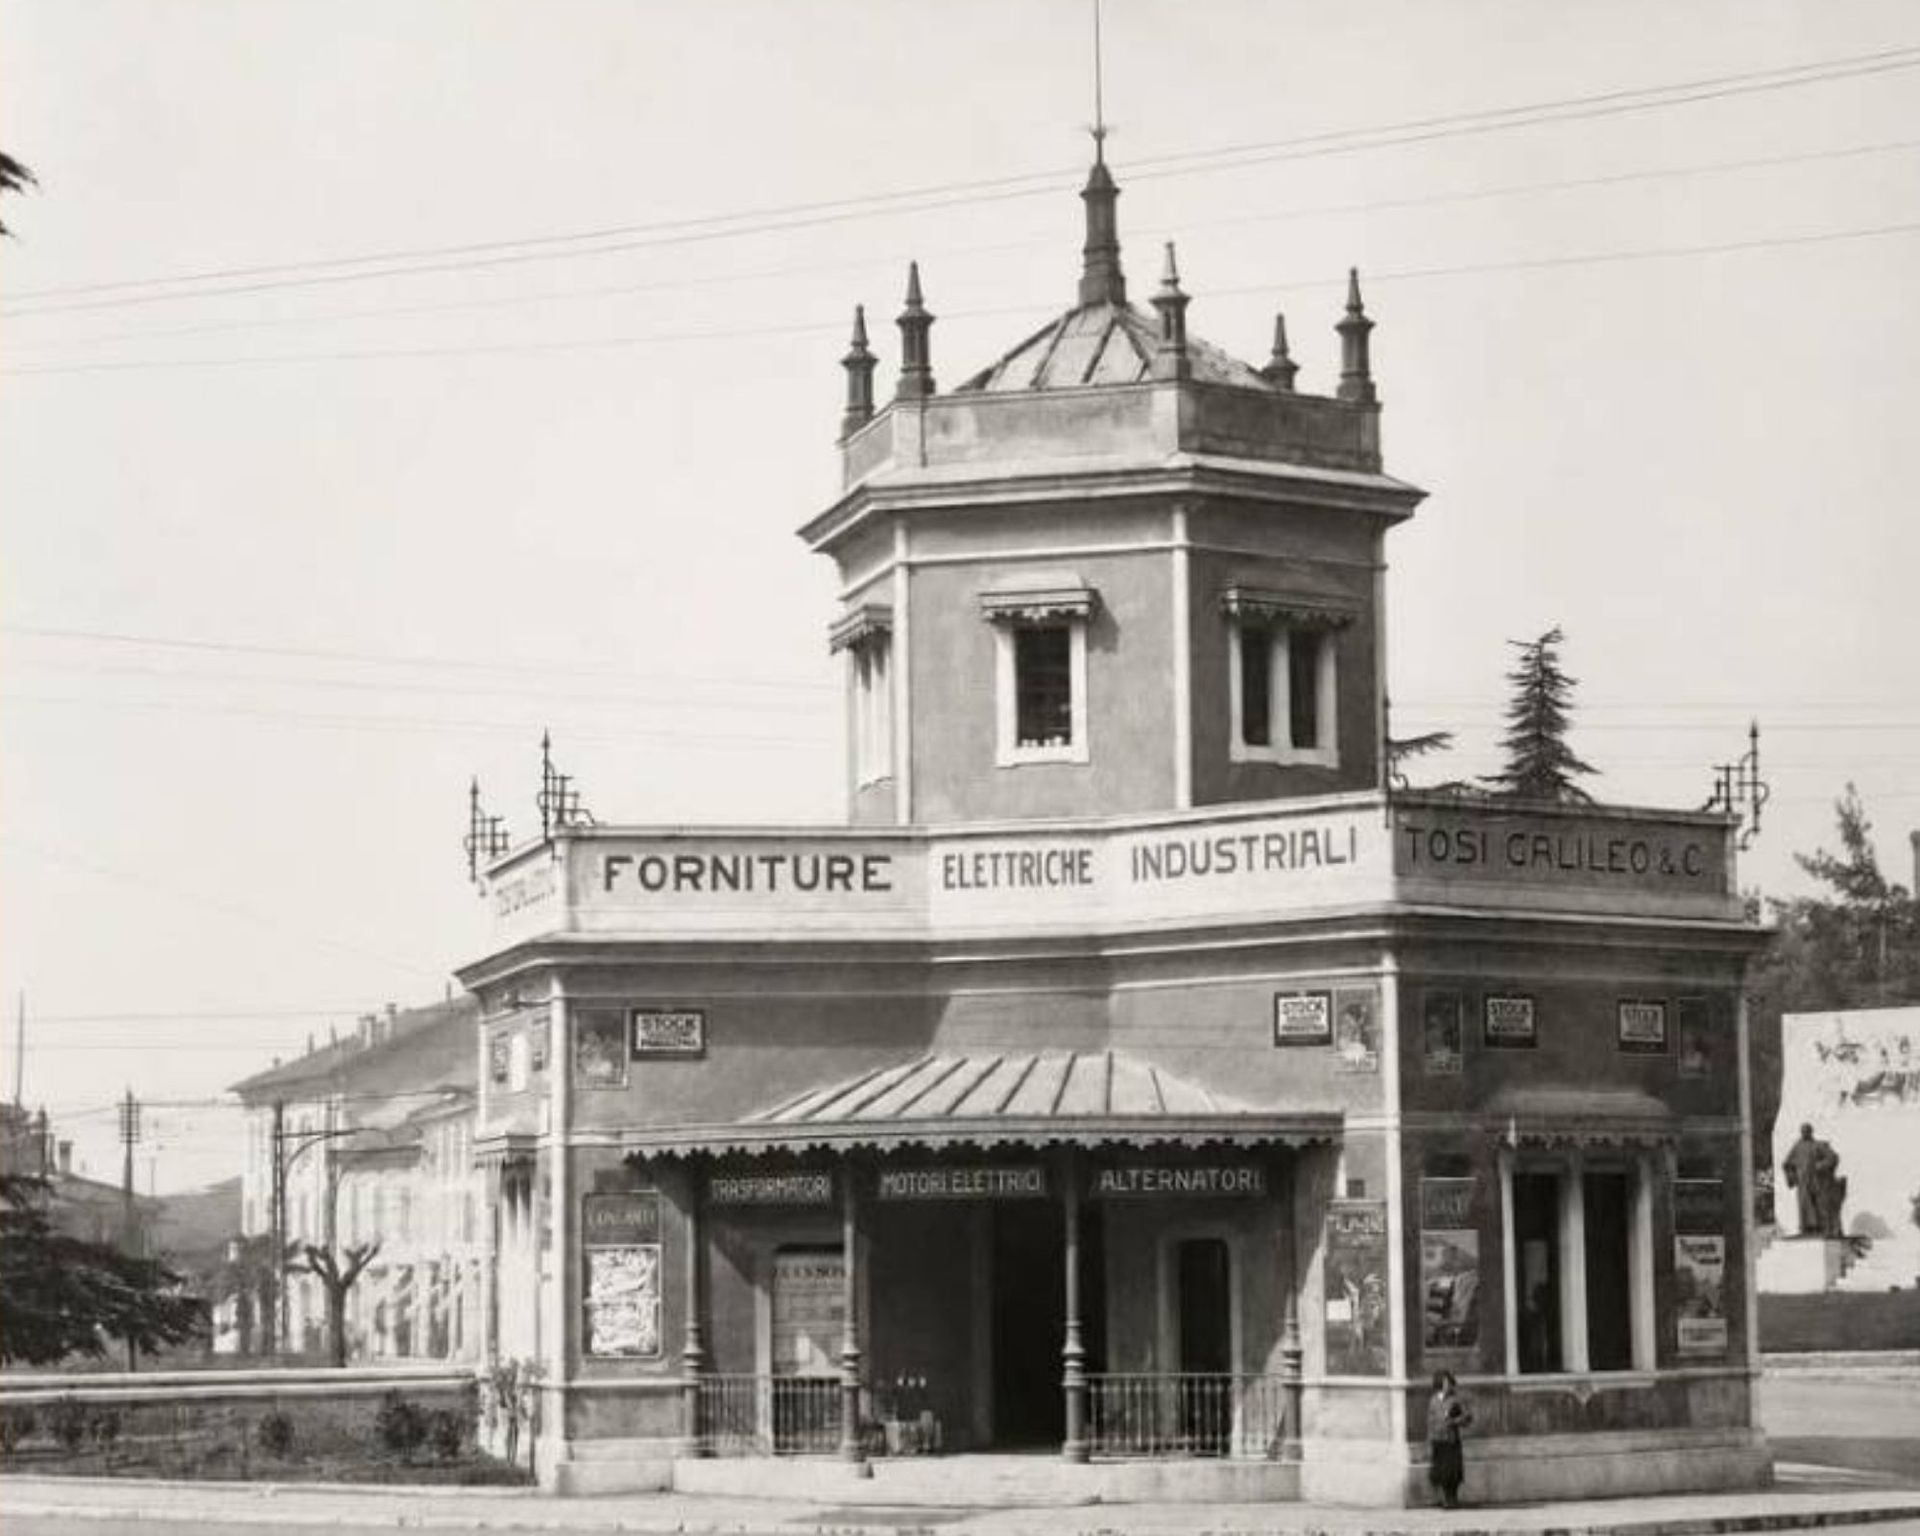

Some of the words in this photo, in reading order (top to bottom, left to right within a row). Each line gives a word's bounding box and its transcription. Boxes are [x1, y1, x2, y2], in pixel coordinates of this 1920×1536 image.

[604, 855, 892, 891] FORNITURE
[943, 848, 1094, 889] ELETTRICHE
[1131, 825, 1357, 882] INDUSTRIALI
[1404, 827, 1487, 864] TOSI
[1506, 832, 1649, 874] GALILEO
[1660, 849, 1675, 875] &
[880, 1170, 947, 1194] MOTORI
[952, 1168, 1042, 1193] ELETTRICI
[1101, 1168, 1261, 1191] ALTERNATORI
